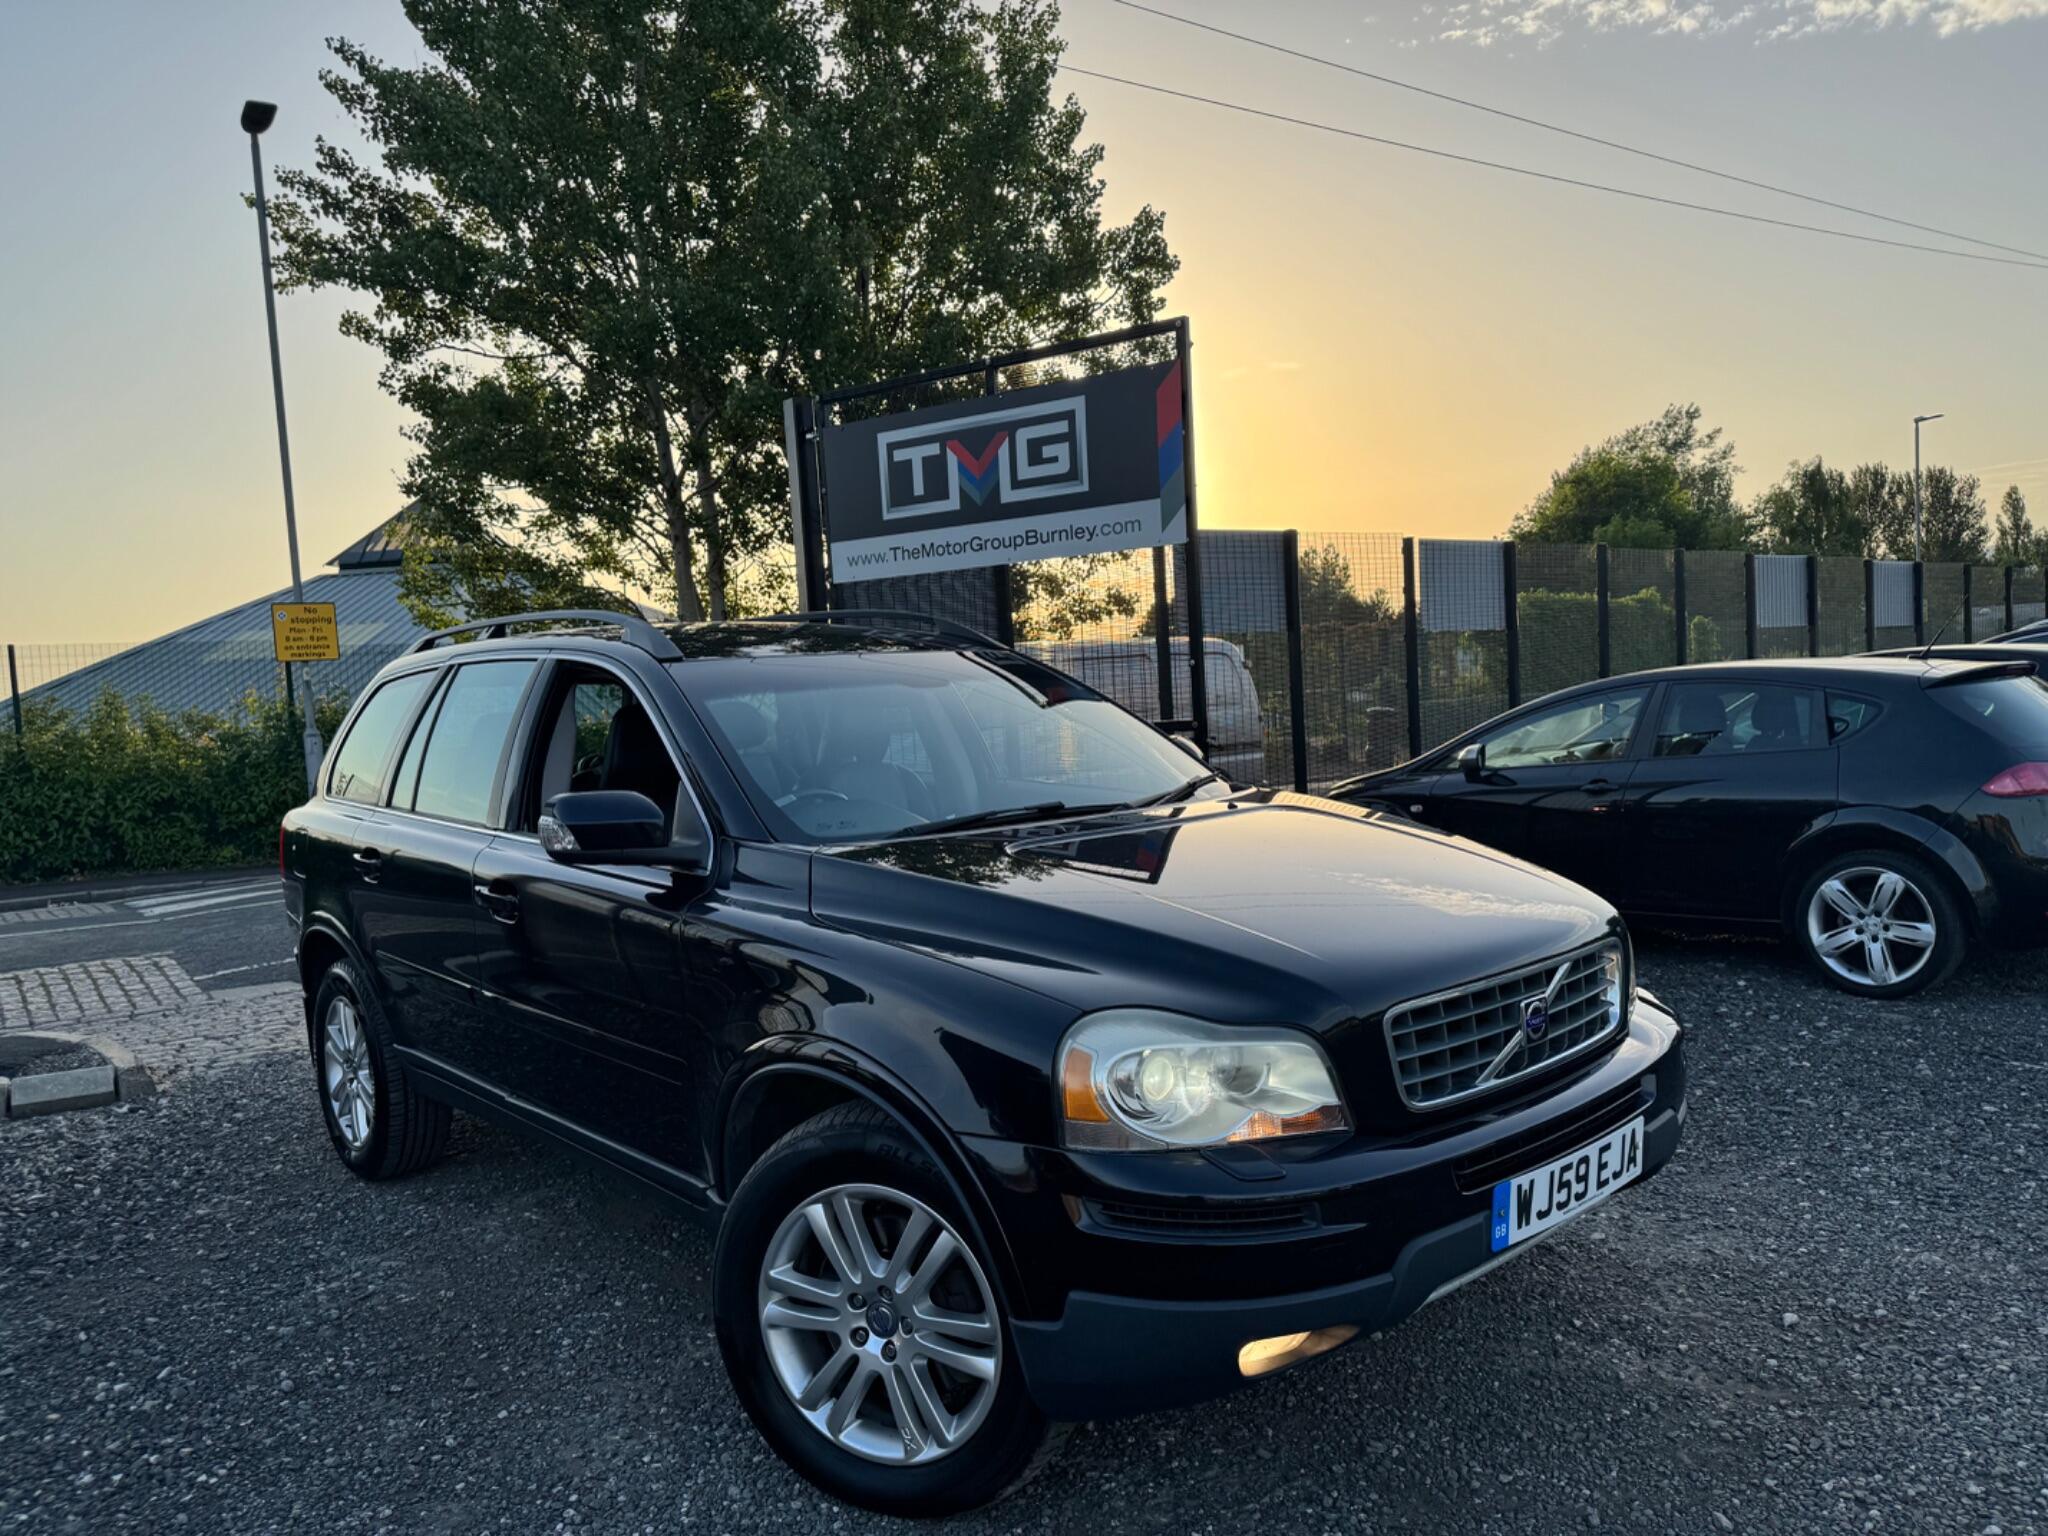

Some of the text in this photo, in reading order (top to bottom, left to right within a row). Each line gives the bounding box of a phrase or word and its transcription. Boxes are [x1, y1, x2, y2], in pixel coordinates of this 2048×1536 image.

[893, 420, 1070, 505] TMG
[847, 517, 1142, 567] www.TheMotorGroupBurnley.com
[303, 606, 318, 614] No
[291, 615, 332, 624] stopping
[296, 643, 330, 651] entrance
[1516, 1127, 1640, 1230] WJ59 EJA
[1495, 1223, 1507, 1239] GB
